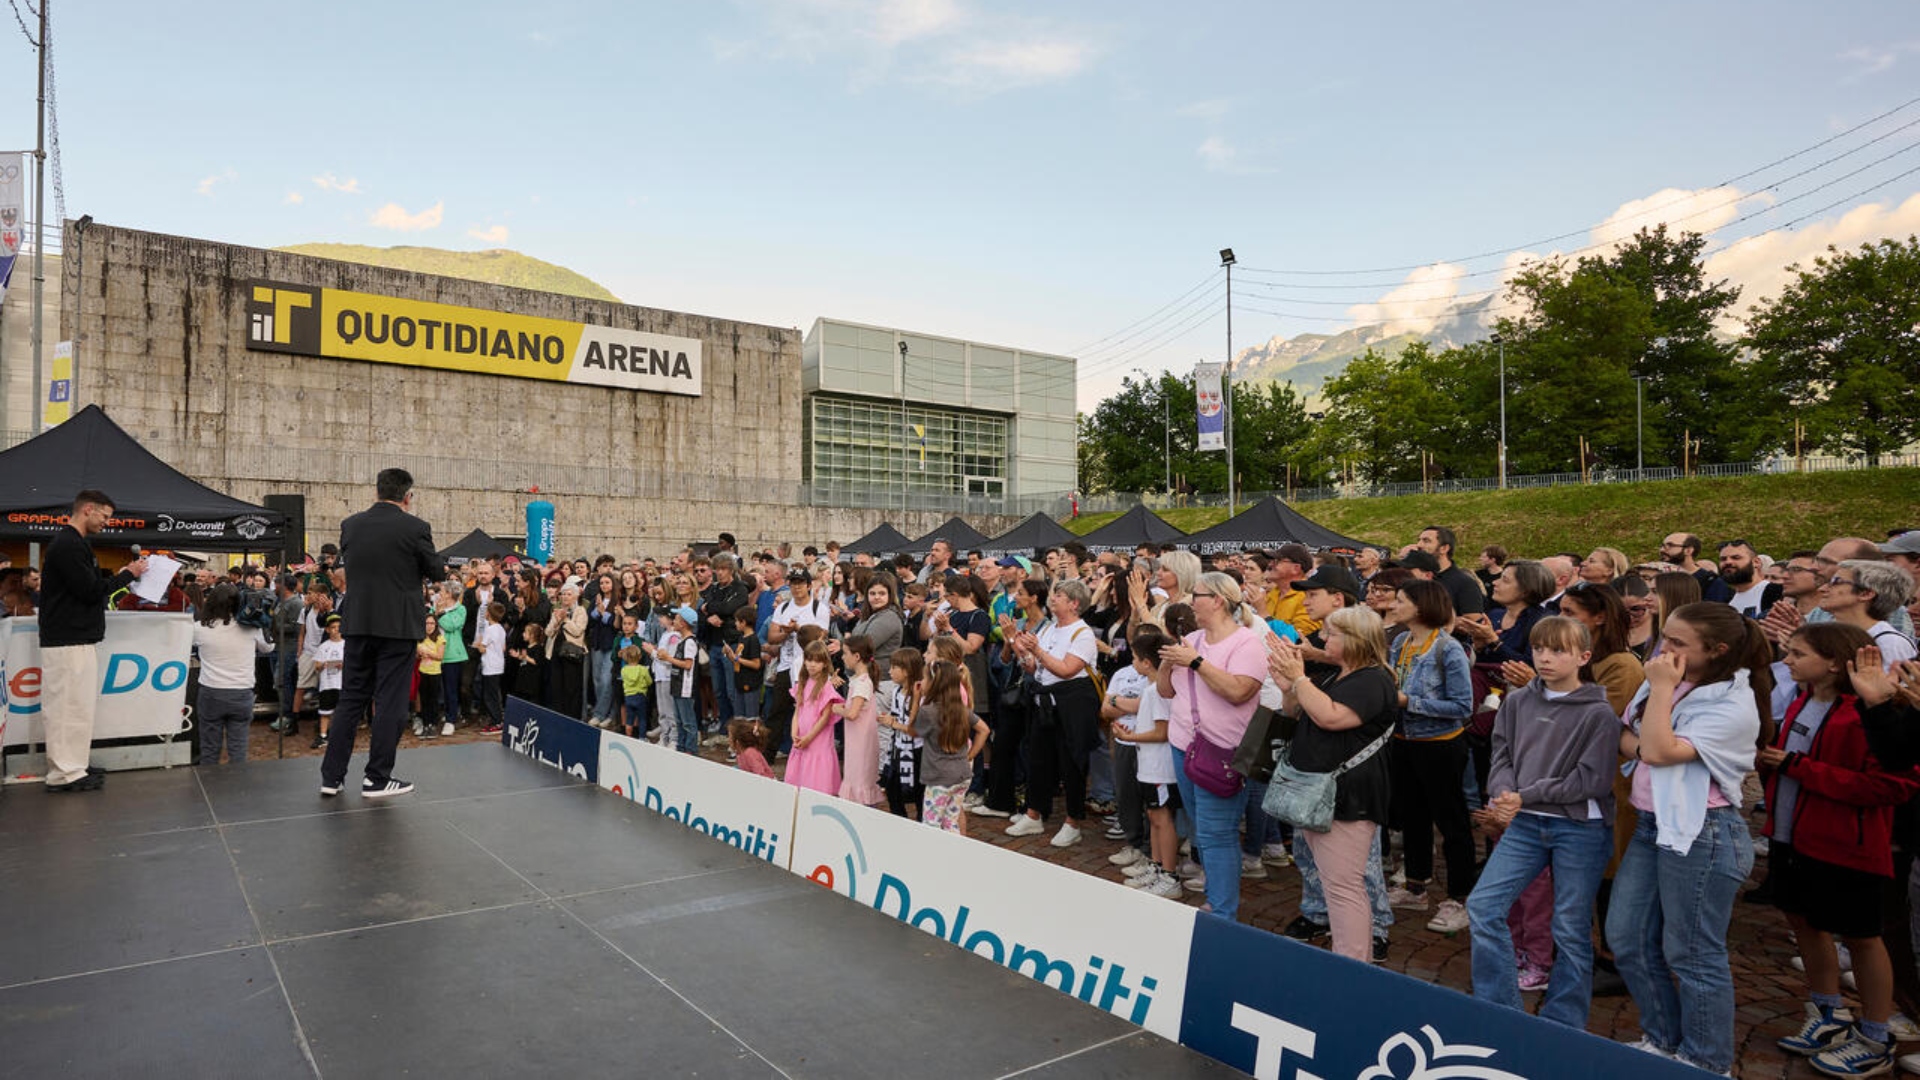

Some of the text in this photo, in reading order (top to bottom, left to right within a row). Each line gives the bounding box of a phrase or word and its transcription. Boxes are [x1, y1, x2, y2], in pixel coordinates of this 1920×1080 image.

[337, 309, 693, 380] QUOTIDIANO ARENA
[175, 521, 226, 531] Dolomiti
[540, 518, 548, 551] Gruppo
[101, 653, 188, 694] Do
